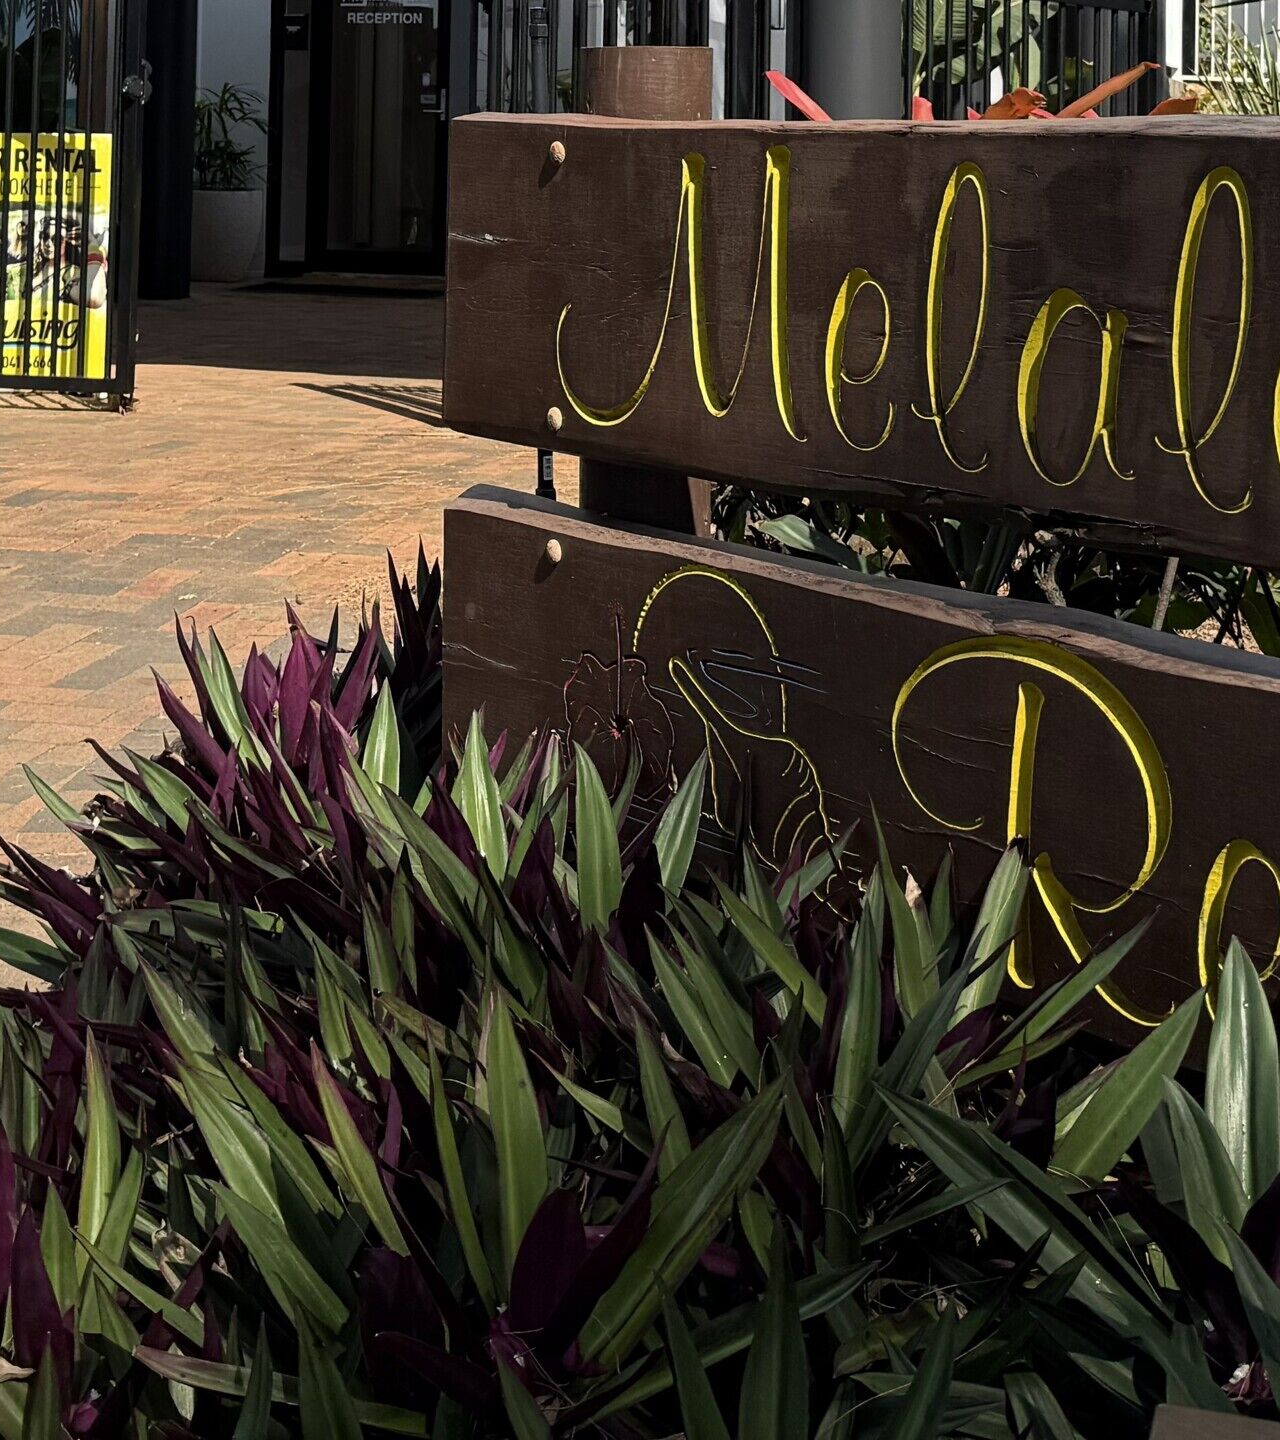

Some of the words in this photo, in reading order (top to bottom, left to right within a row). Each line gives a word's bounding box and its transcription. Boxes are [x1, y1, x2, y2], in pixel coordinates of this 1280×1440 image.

[347, 12, 423, 24] RECEPTION
[15, 148, 102, 172] RENTAL
[34, 179, 73, 196] HEE
